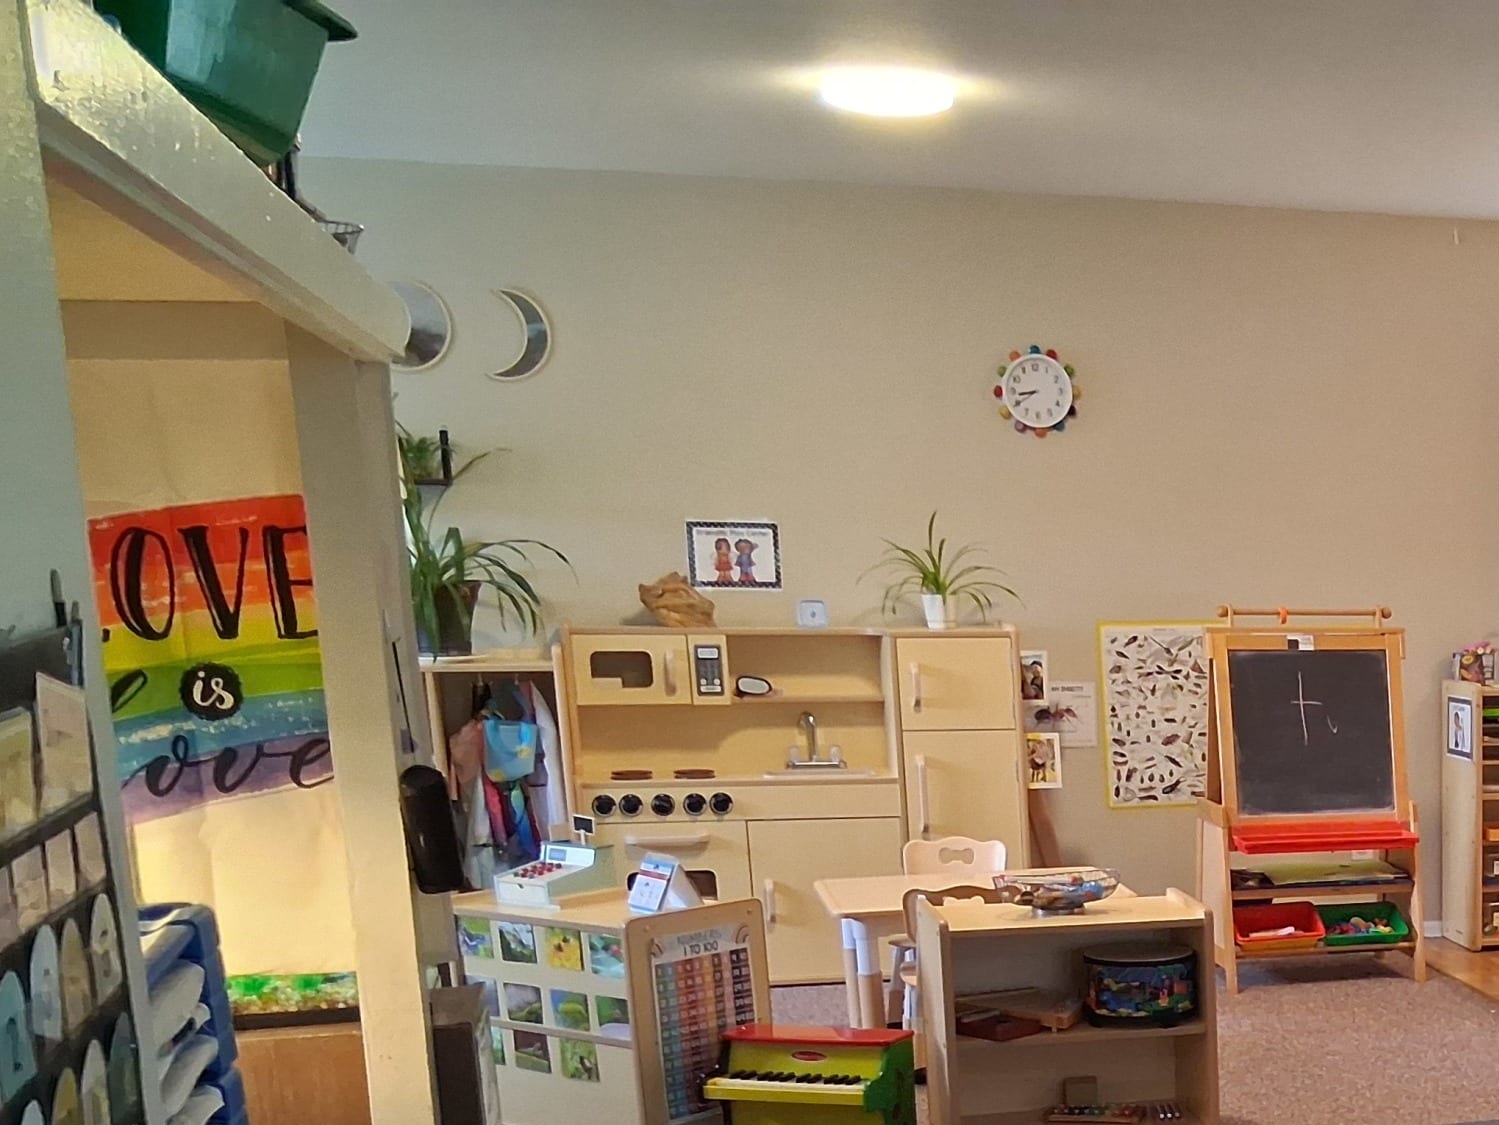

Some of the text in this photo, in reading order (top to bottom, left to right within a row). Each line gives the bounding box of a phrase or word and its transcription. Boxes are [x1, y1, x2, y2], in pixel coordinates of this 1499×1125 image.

[102, 524, 318, 642] OVE
[191, 670, 235, 710] is
[690, 943, 700, 955] TO
[704, 940, 719, 953] 100
